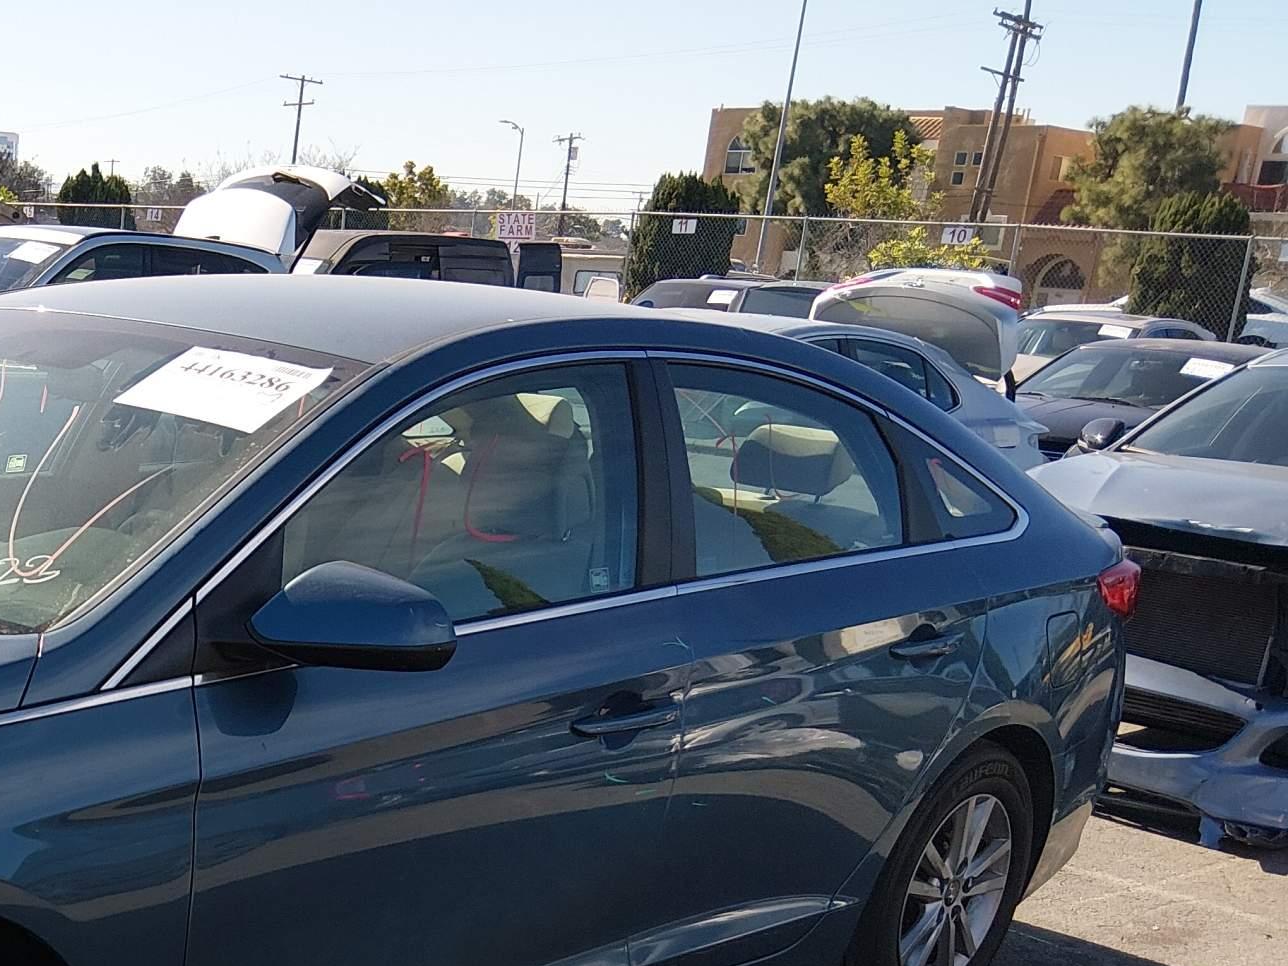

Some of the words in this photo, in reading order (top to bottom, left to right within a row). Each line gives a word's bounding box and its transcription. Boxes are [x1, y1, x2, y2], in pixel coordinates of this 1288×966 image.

[498, 213, 535, 224] STATE
[499, 225, 532, 236] FARM
[678, 219, 689, 232] 11
[949, 229, 968, 243] 10
[180, 360, 295, 393] 44163286
